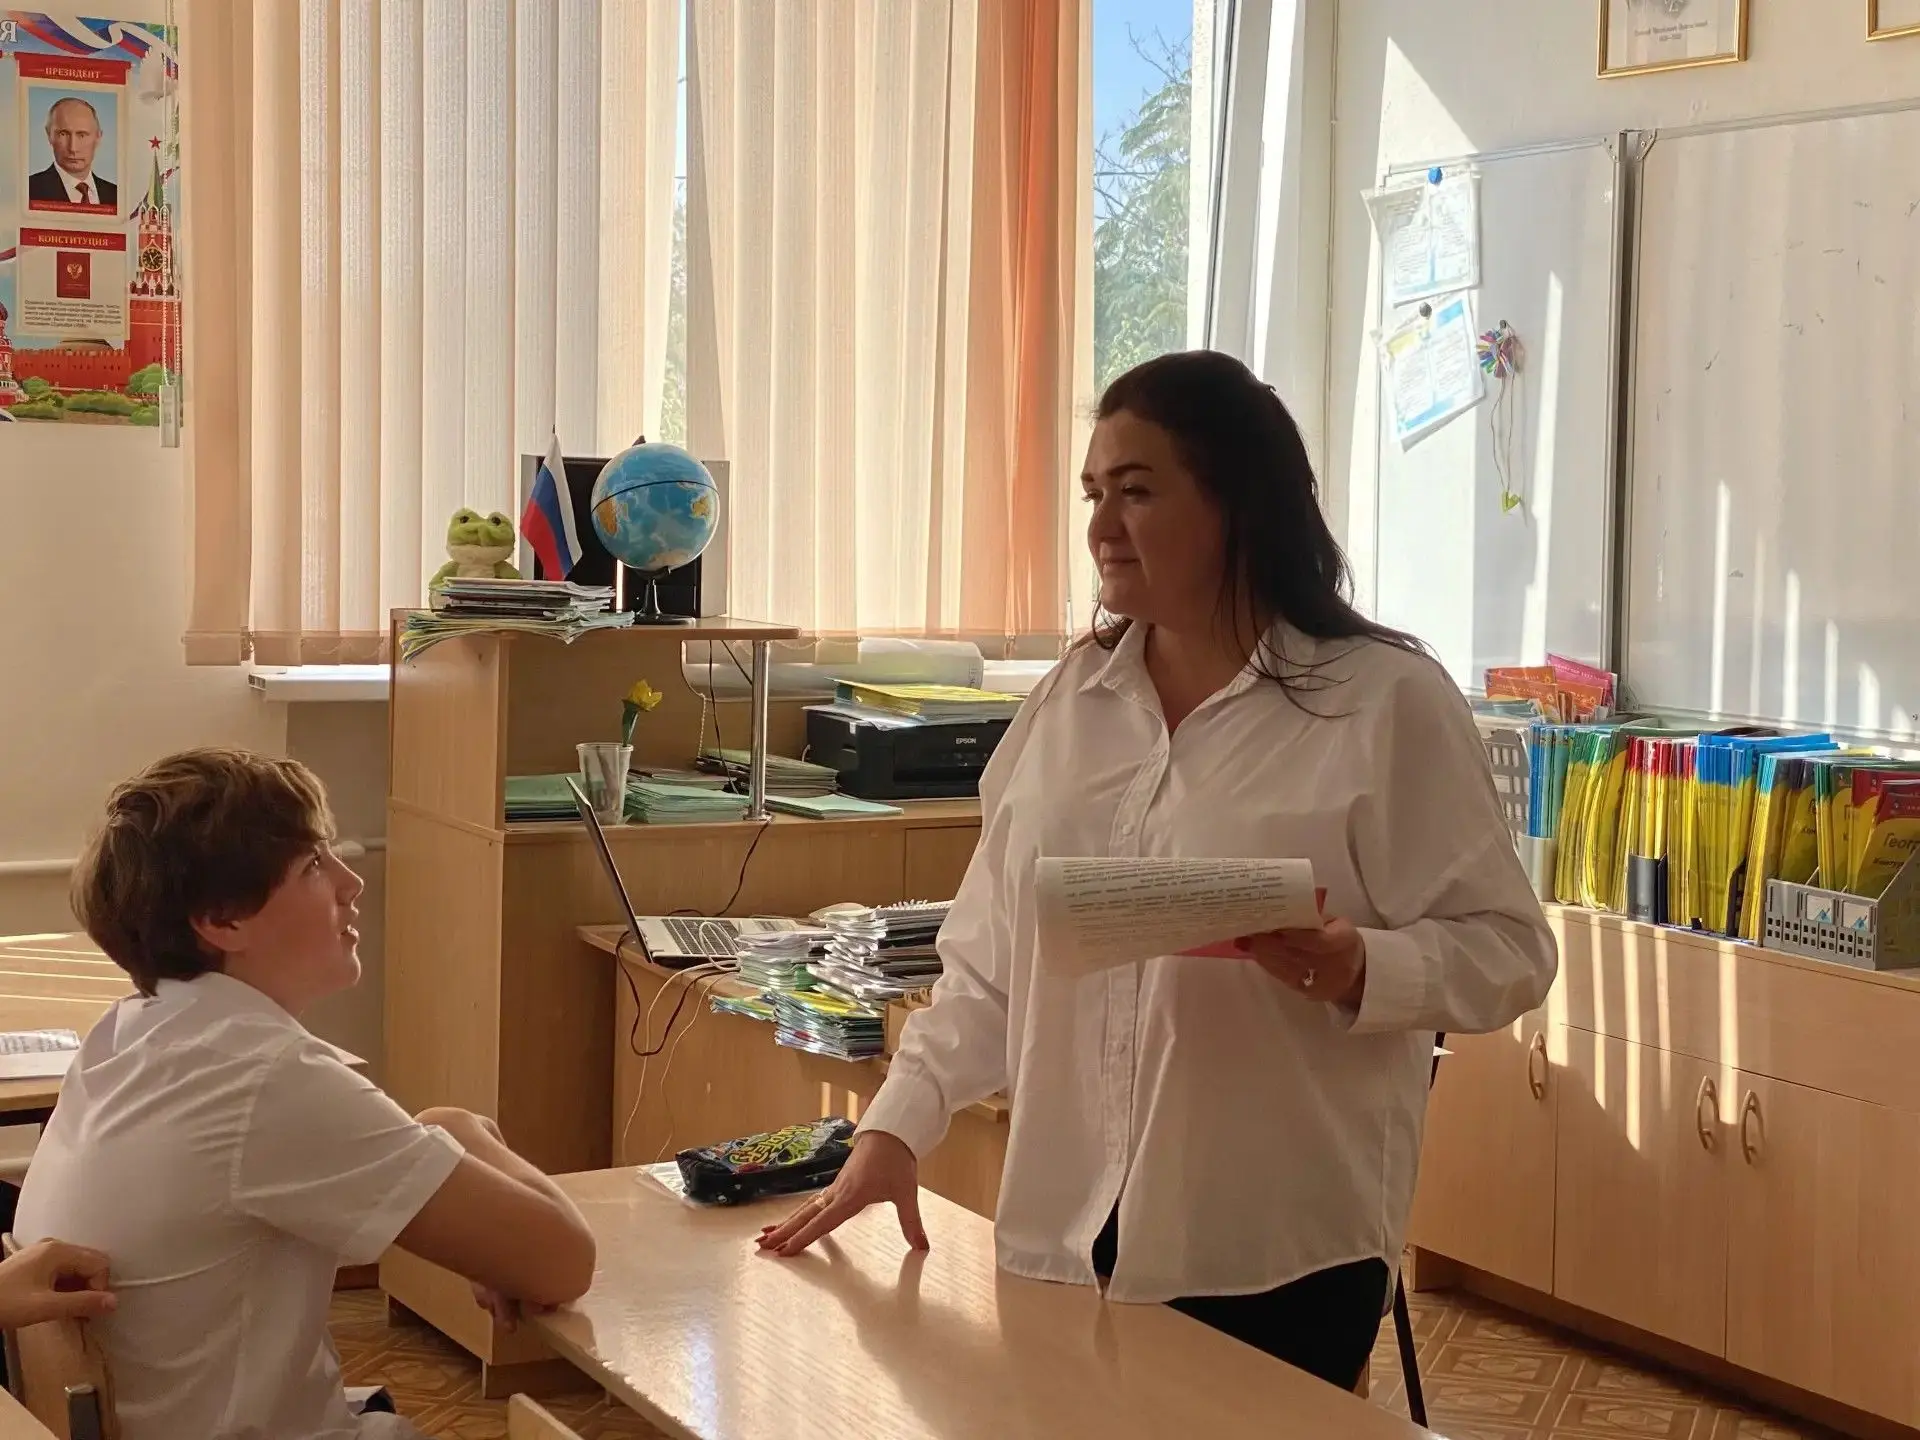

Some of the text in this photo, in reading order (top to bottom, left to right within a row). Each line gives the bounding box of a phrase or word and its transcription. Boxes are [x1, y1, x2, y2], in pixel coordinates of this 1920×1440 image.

[45, 67, 100, 79] ПРЕЗИДЕНТ
[38, 234, 109, 247] КОНСТИТУЦИЯ
[955, 737, 977, 745] EPSON
